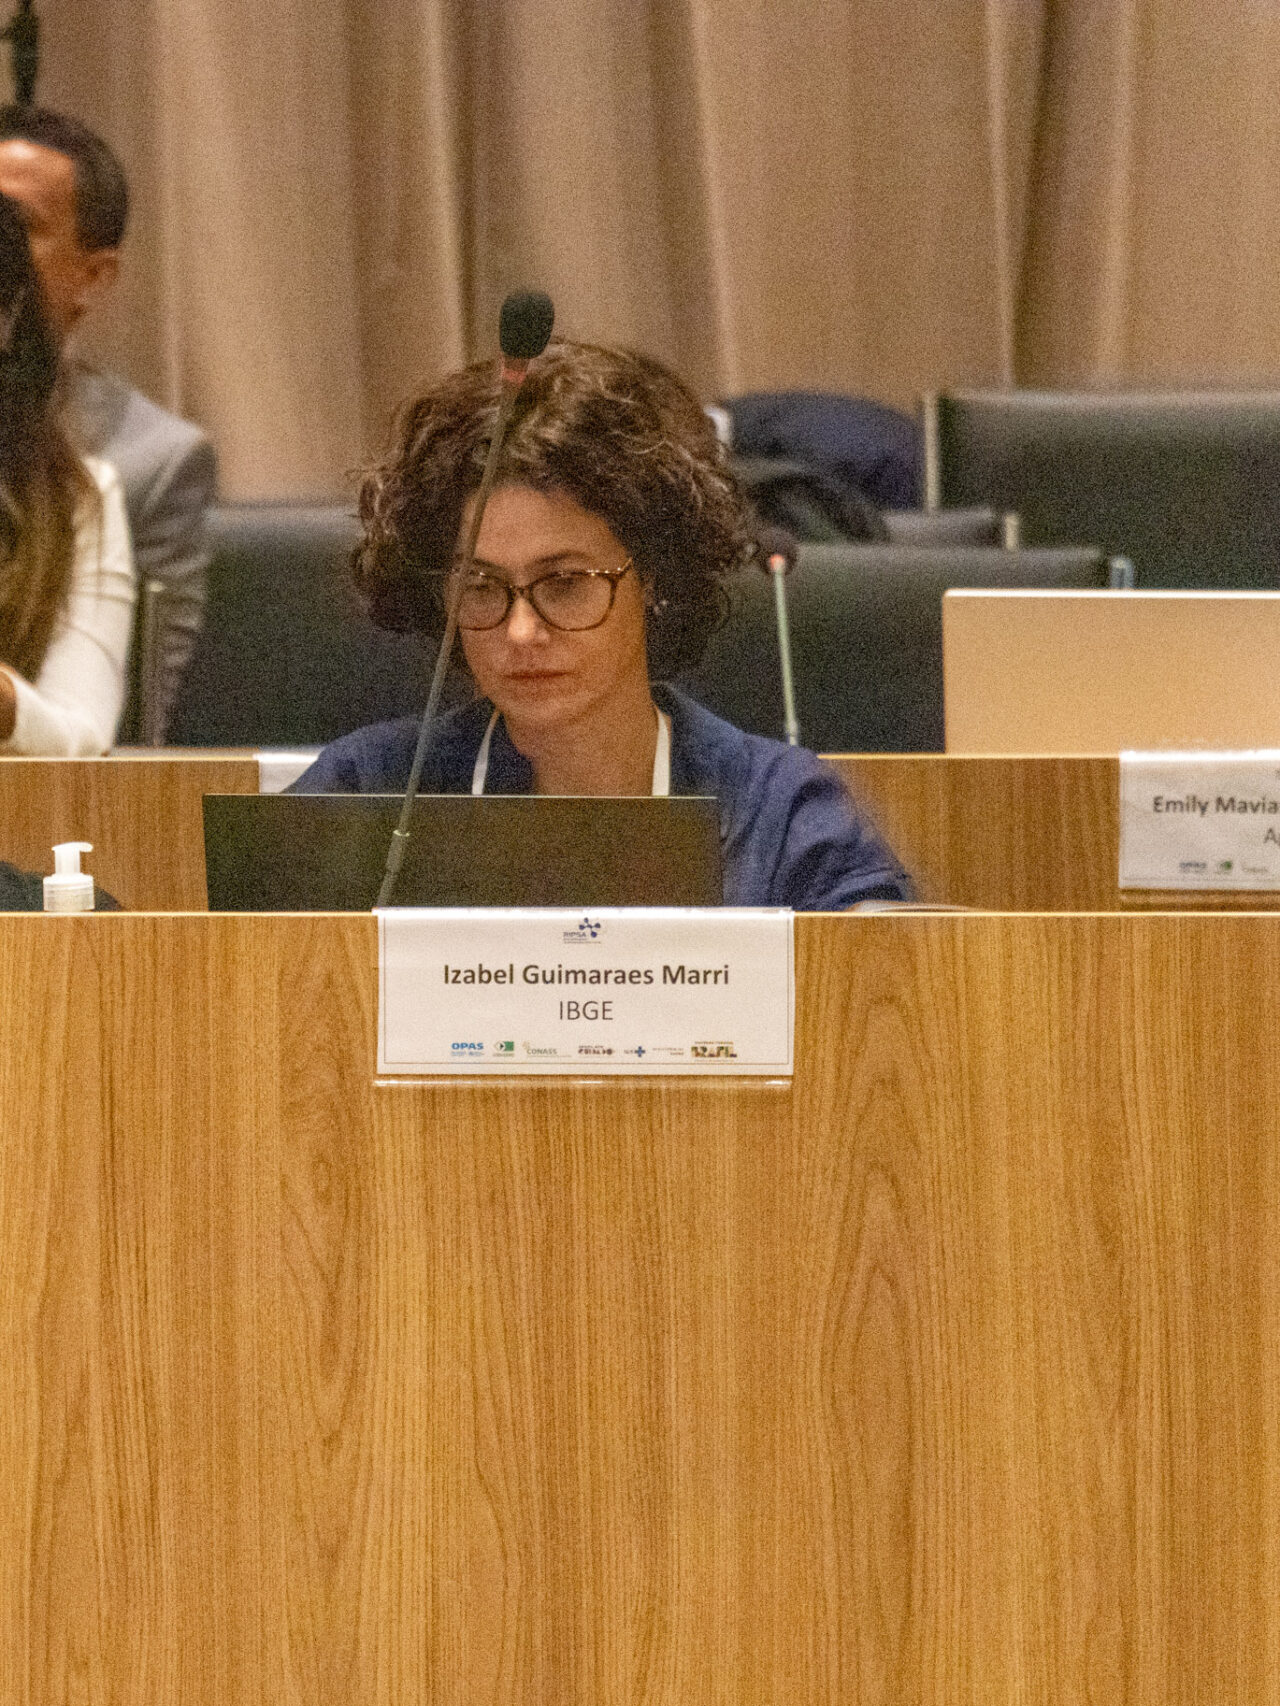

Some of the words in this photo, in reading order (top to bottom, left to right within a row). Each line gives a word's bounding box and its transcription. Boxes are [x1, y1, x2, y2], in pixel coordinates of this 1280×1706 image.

[1153, 795, 1209, 817] Emily
[1215, 795, 1280, 814] Mavia
[443, 963, 515, 985] Izabel
[521, 963, 655, 986] Guimaraes
[662, 964, 729, 985] Marri
[559, 1000, 614, 1021] IBGE
[451, 1042, 484, 1050] OPAS
